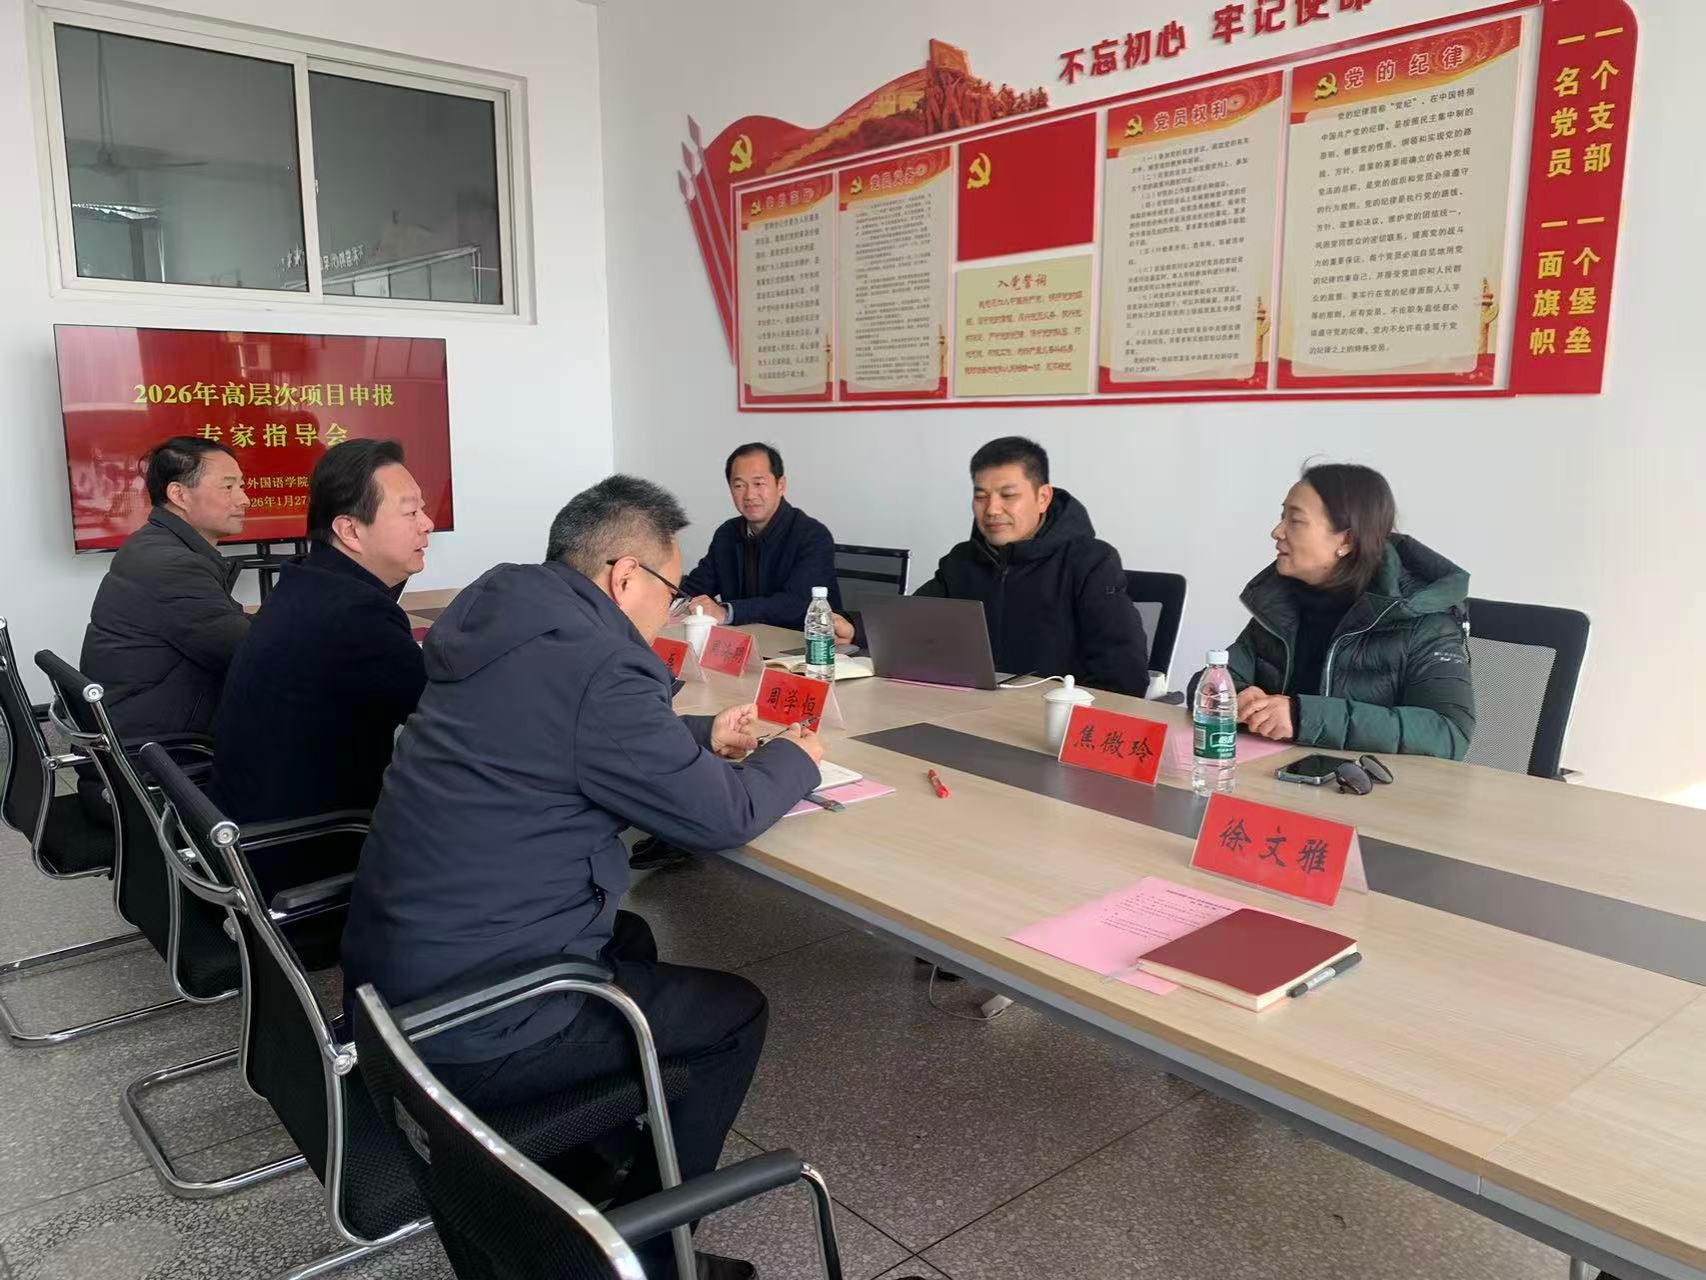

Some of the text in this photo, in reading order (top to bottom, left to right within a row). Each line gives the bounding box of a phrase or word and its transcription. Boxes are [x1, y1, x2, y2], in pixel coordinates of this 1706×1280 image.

[1058, 20, 1185, 84] 不忘初心
[1344, 45, 1464, 89] 党的纪律
[1154, 99, 1229, 132] 党员权利
[133, 381, 395, 407] 2026年高层次项目申报
[196, 422, 349, 448] 专家指导会
[247, 476, 309, 490] 外国语学院
[249, 496, 311, 508] 26年1月27
[1218, 819, 1329, 873] 徐文雅
